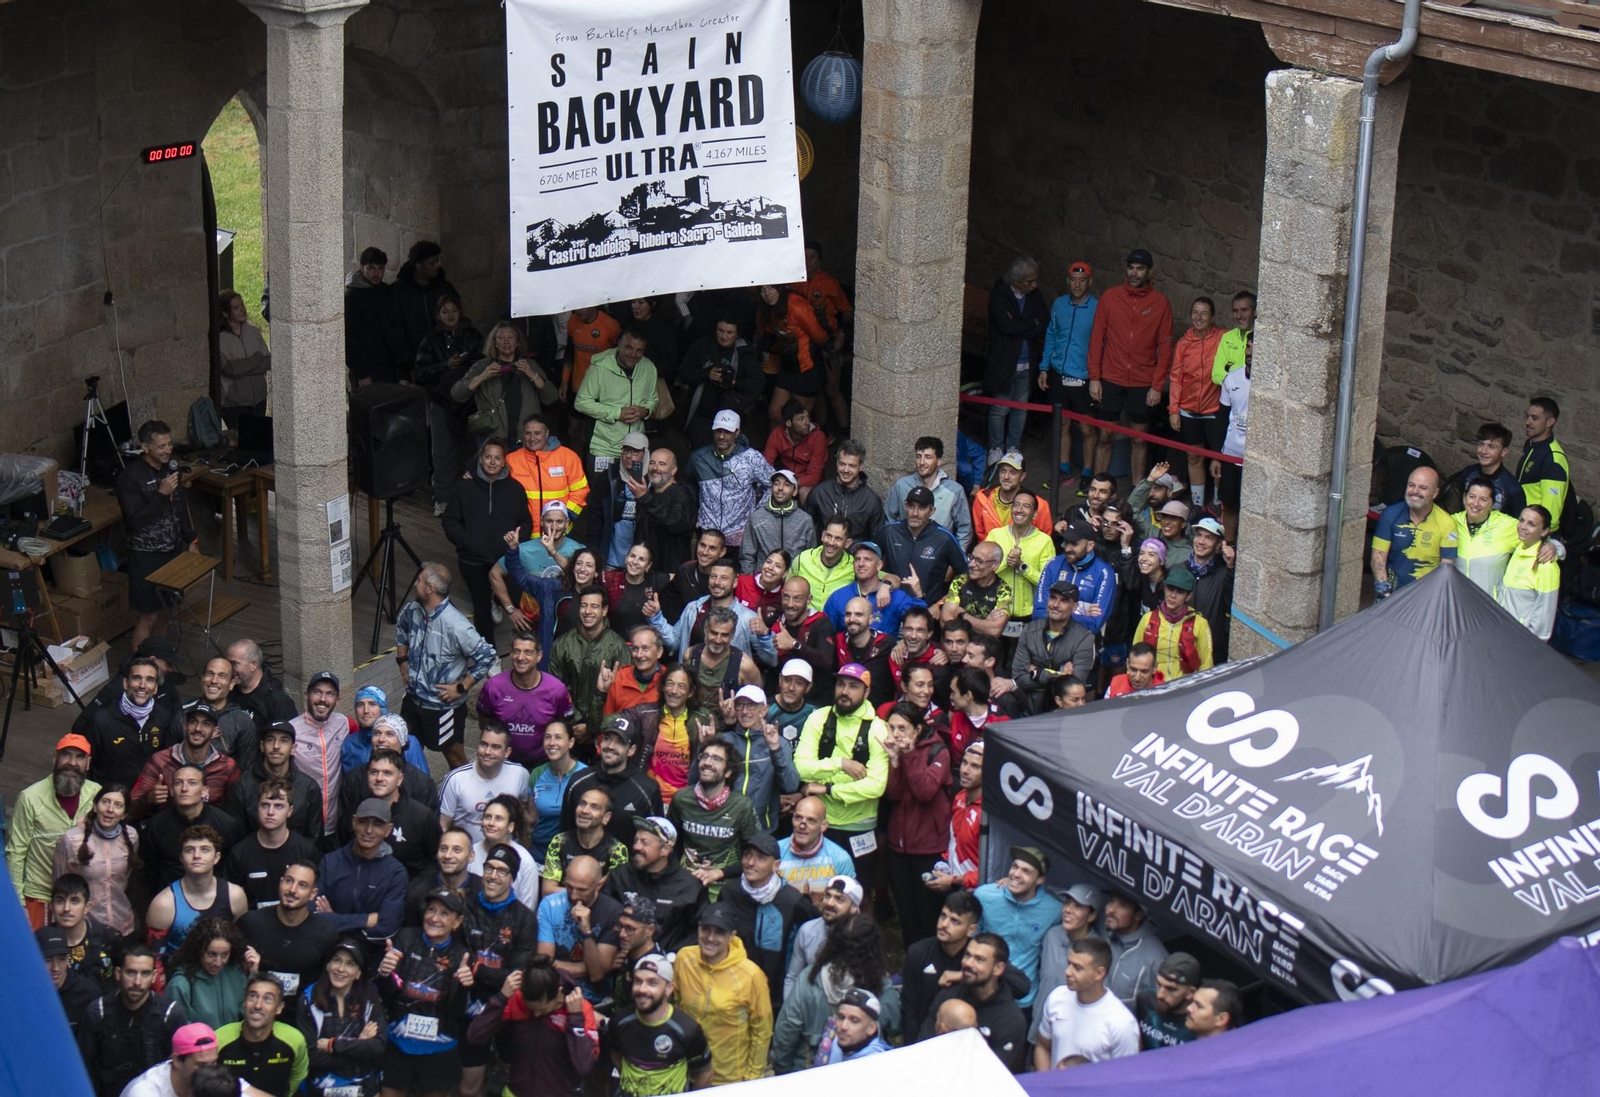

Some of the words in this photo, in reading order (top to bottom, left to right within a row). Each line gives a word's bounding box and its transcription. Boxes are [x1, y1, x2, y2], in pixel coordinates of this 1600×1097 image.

[555, 32, 578, 44] From
[586, 26, 638, 42] Barkley's
[645, 20, 694, 36] Marathon
[700, 13, 740, 29] Creator
[537, 74, 764, 155] BACKYARD
[705, 147, 733, 160] 4.167
[735, 145, 767, 157] MILES
[539, 172, 564, 186] 6706
[566, 166, 598, 182] METER
[548, 245, 586, 266] Castro
[588, 237, 631, 259] Caldelas
[639, 230, 678, 249] Ribeira
[679, 224, 714, 246] Sacra
[723, 221, 763, 240] Galicia
[508, 722, 535, 733] DARK
[1131, 731, 1279, 819] INFINITE
[1269, 805, 1380, 877] RACE
[1111, 753, 1170, 805] VAL
[1172, 793, 1315, 881] D'ARAN
[1076, 790, 1204, 891] INFINITE
[1212, 867, 1306, 949] RACE
[1321, 865, 1349, 883] BACK
[1303, 881, 1333, 902] ULTRA
[1314, 873, 1338, 891] YARD
[1077, 824, 1135, 887] VAL
[1142, 865, 1264, 965] D'ARAN
[1272, 940, 1296, 960] BACK
[1271, 952, 1293, 972] YARD
[1270, 963, 1298, 987] ULTRA
[414, 1022, 432, 1033] 177
